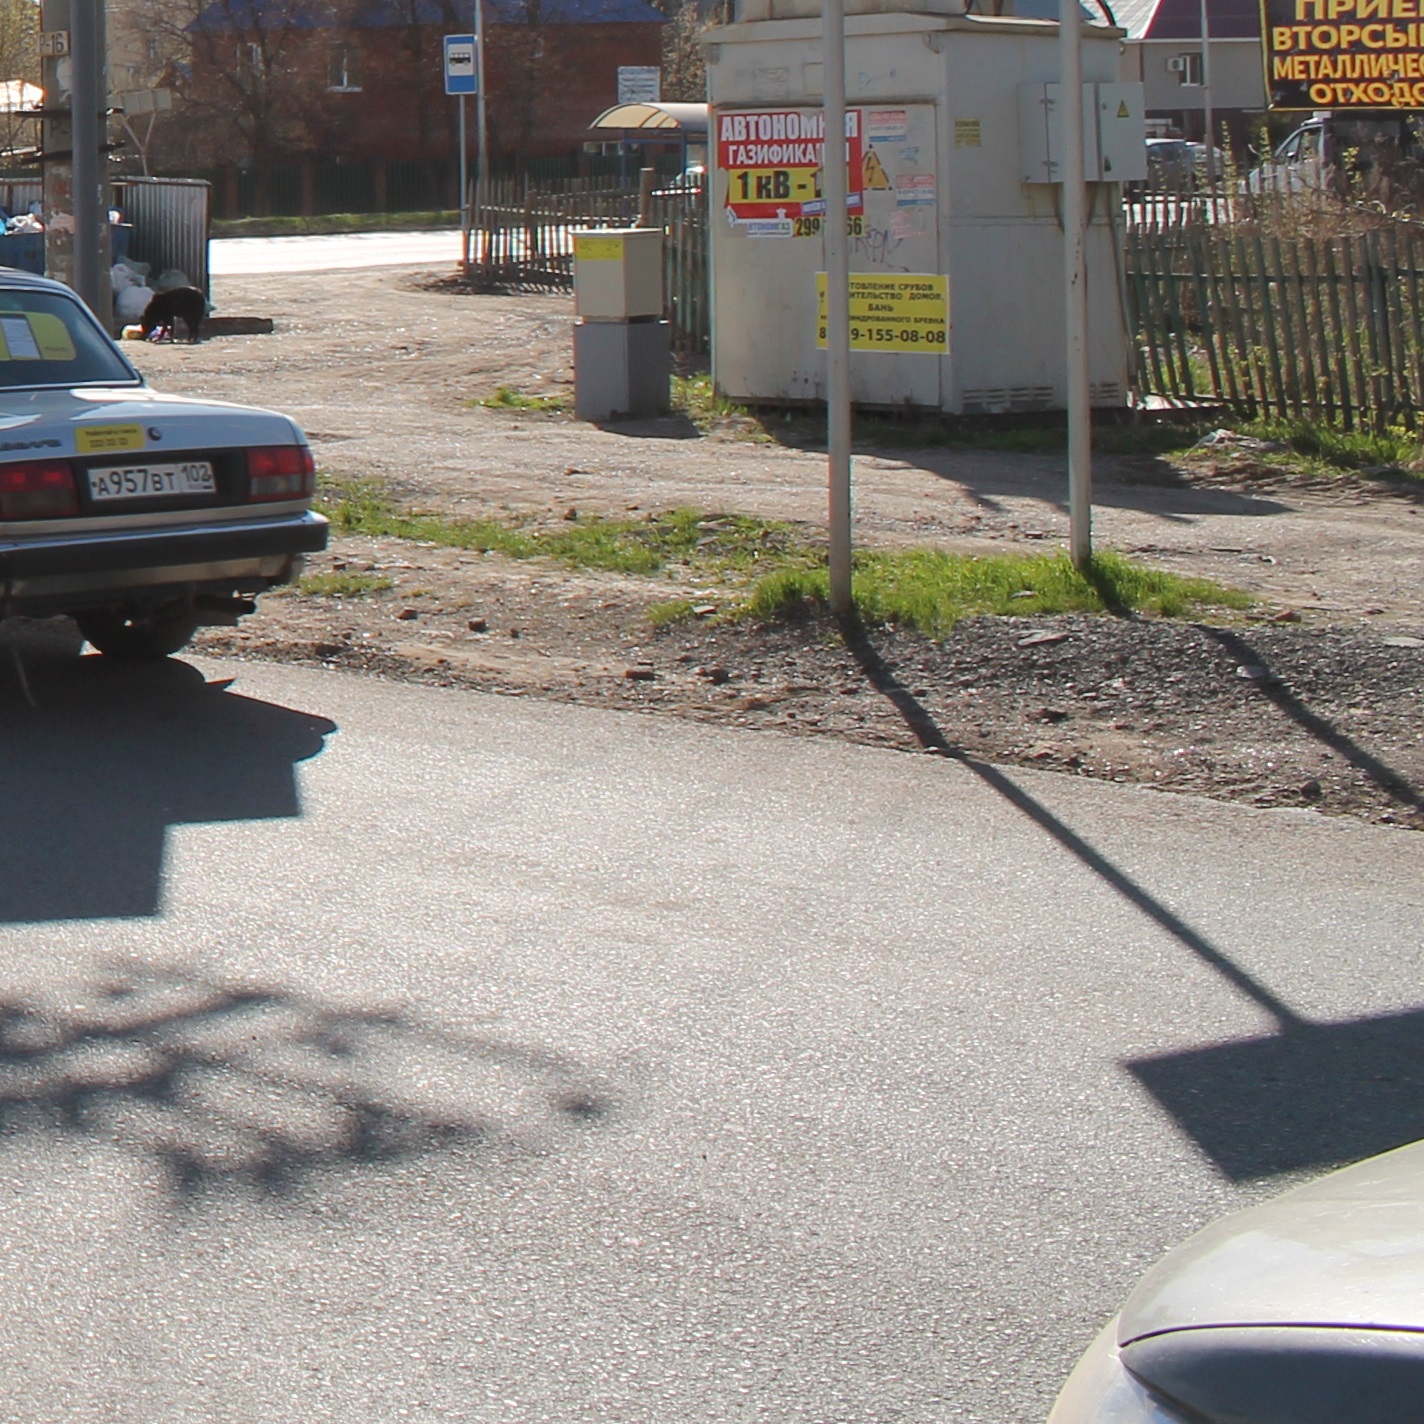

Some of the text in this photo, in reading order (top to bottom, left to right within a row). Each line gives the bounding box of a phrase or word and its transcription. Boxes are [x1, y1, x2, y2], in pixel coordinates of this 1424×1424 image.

[1272, 23, 1424, 51] ВТОРСЫ
[721, 111, 858, 142] АВТОНОМЯ
[728, 142, 850, 165] ГАЗИФИКА
[737, 172, 749, 200] 1
[849, 291, 903, 300] ИТЕЛЬСТВО
[850, 282, 933, 291] ТОВЛЕНИЕ СРУБОВ
[868, 303, 894, 312] БАНЬ
[819, 327, 946, 344] 89-155-08-08
[97, 464, 211, 495] А957ВТ 102
